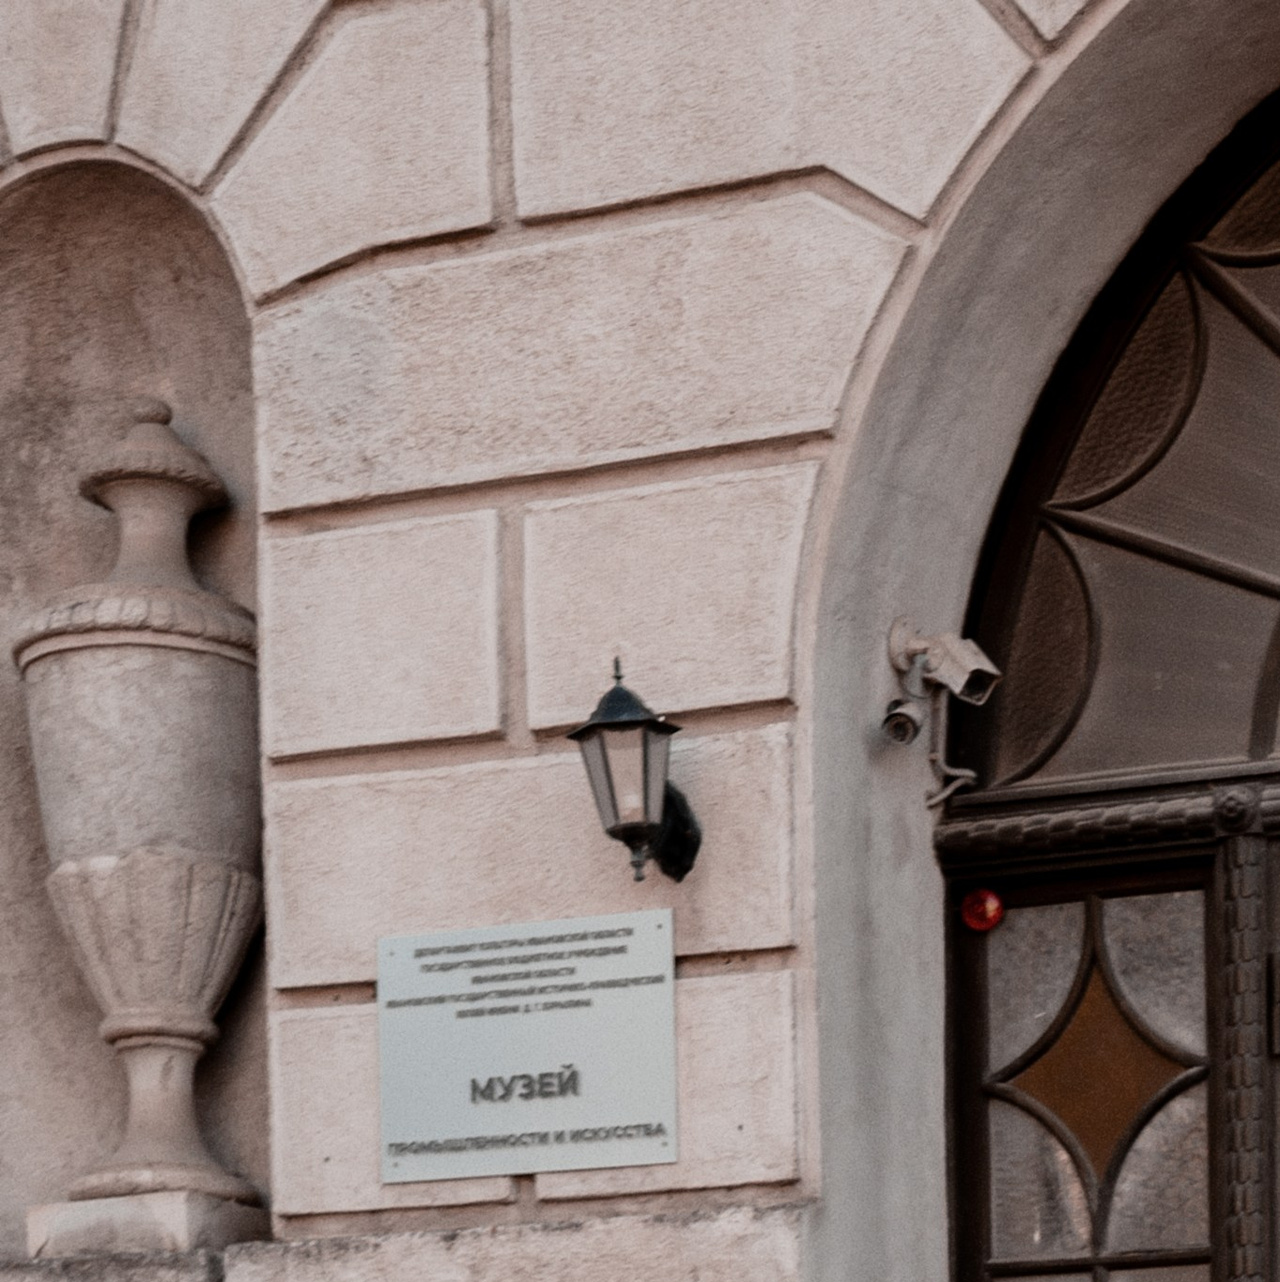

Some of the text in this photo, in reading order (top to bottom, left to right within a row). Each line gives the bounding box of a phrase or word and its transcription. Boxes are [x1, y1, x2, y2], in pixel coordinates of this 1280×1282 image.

[470, 1063, 580, 1104] МУЗЕЙ
[553, 1129, 566, 1144] И
[569, 1123, 667, 1143] ИСКУССТВА
